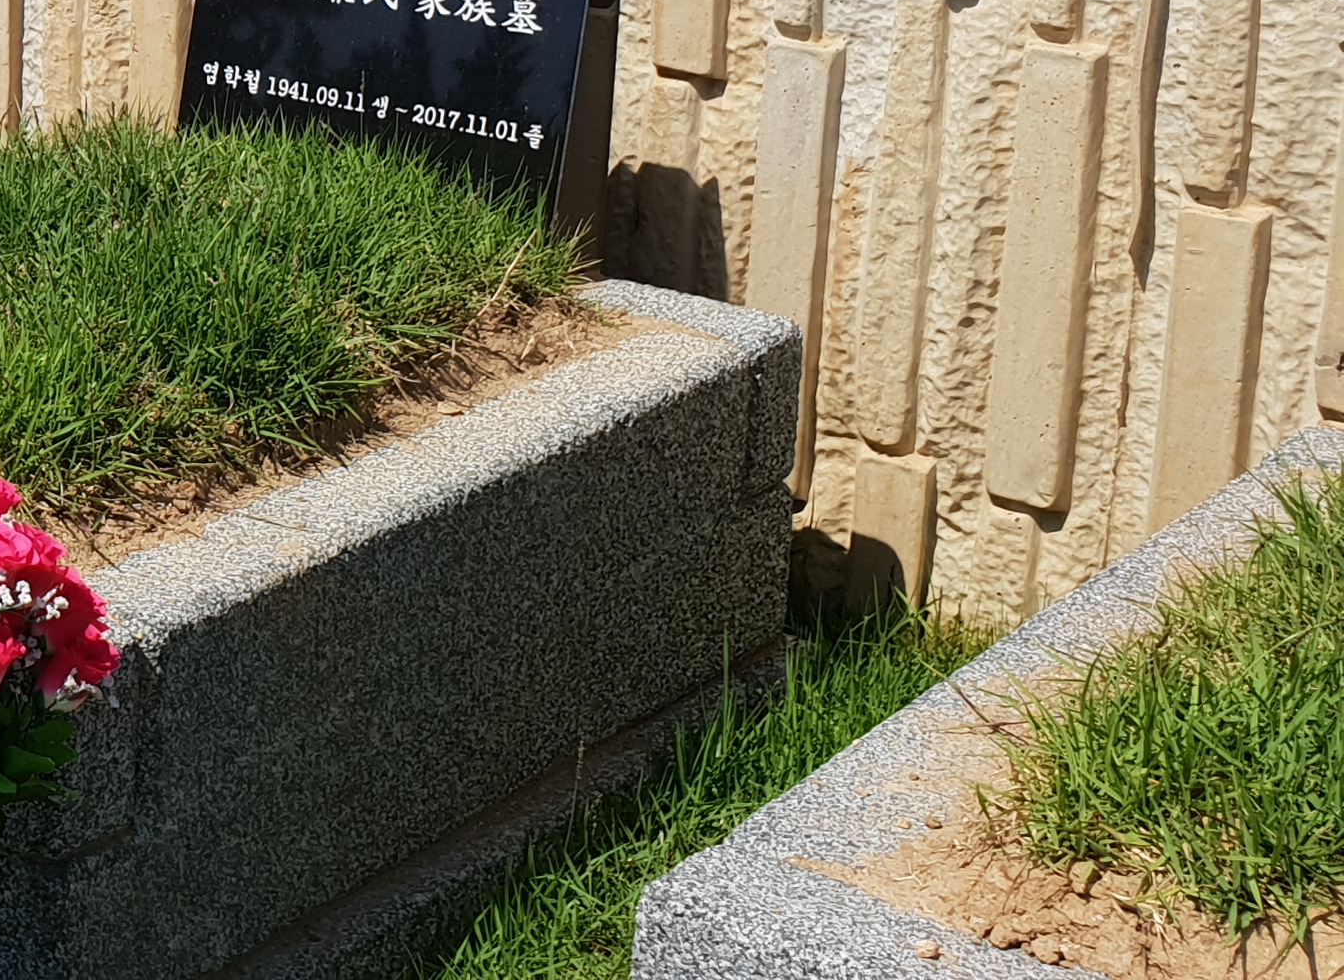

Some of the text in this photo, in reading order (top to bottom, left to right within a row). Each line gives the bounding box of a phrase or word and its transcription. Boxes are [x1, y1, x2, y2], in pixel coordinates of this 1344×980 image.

[266, 76, 365, 113] 1941.09.11
[371, 94, 389, 119] 생
[411, 103, 519, 143] 2017.11.01
[522, 123, 545, 150] 졸
